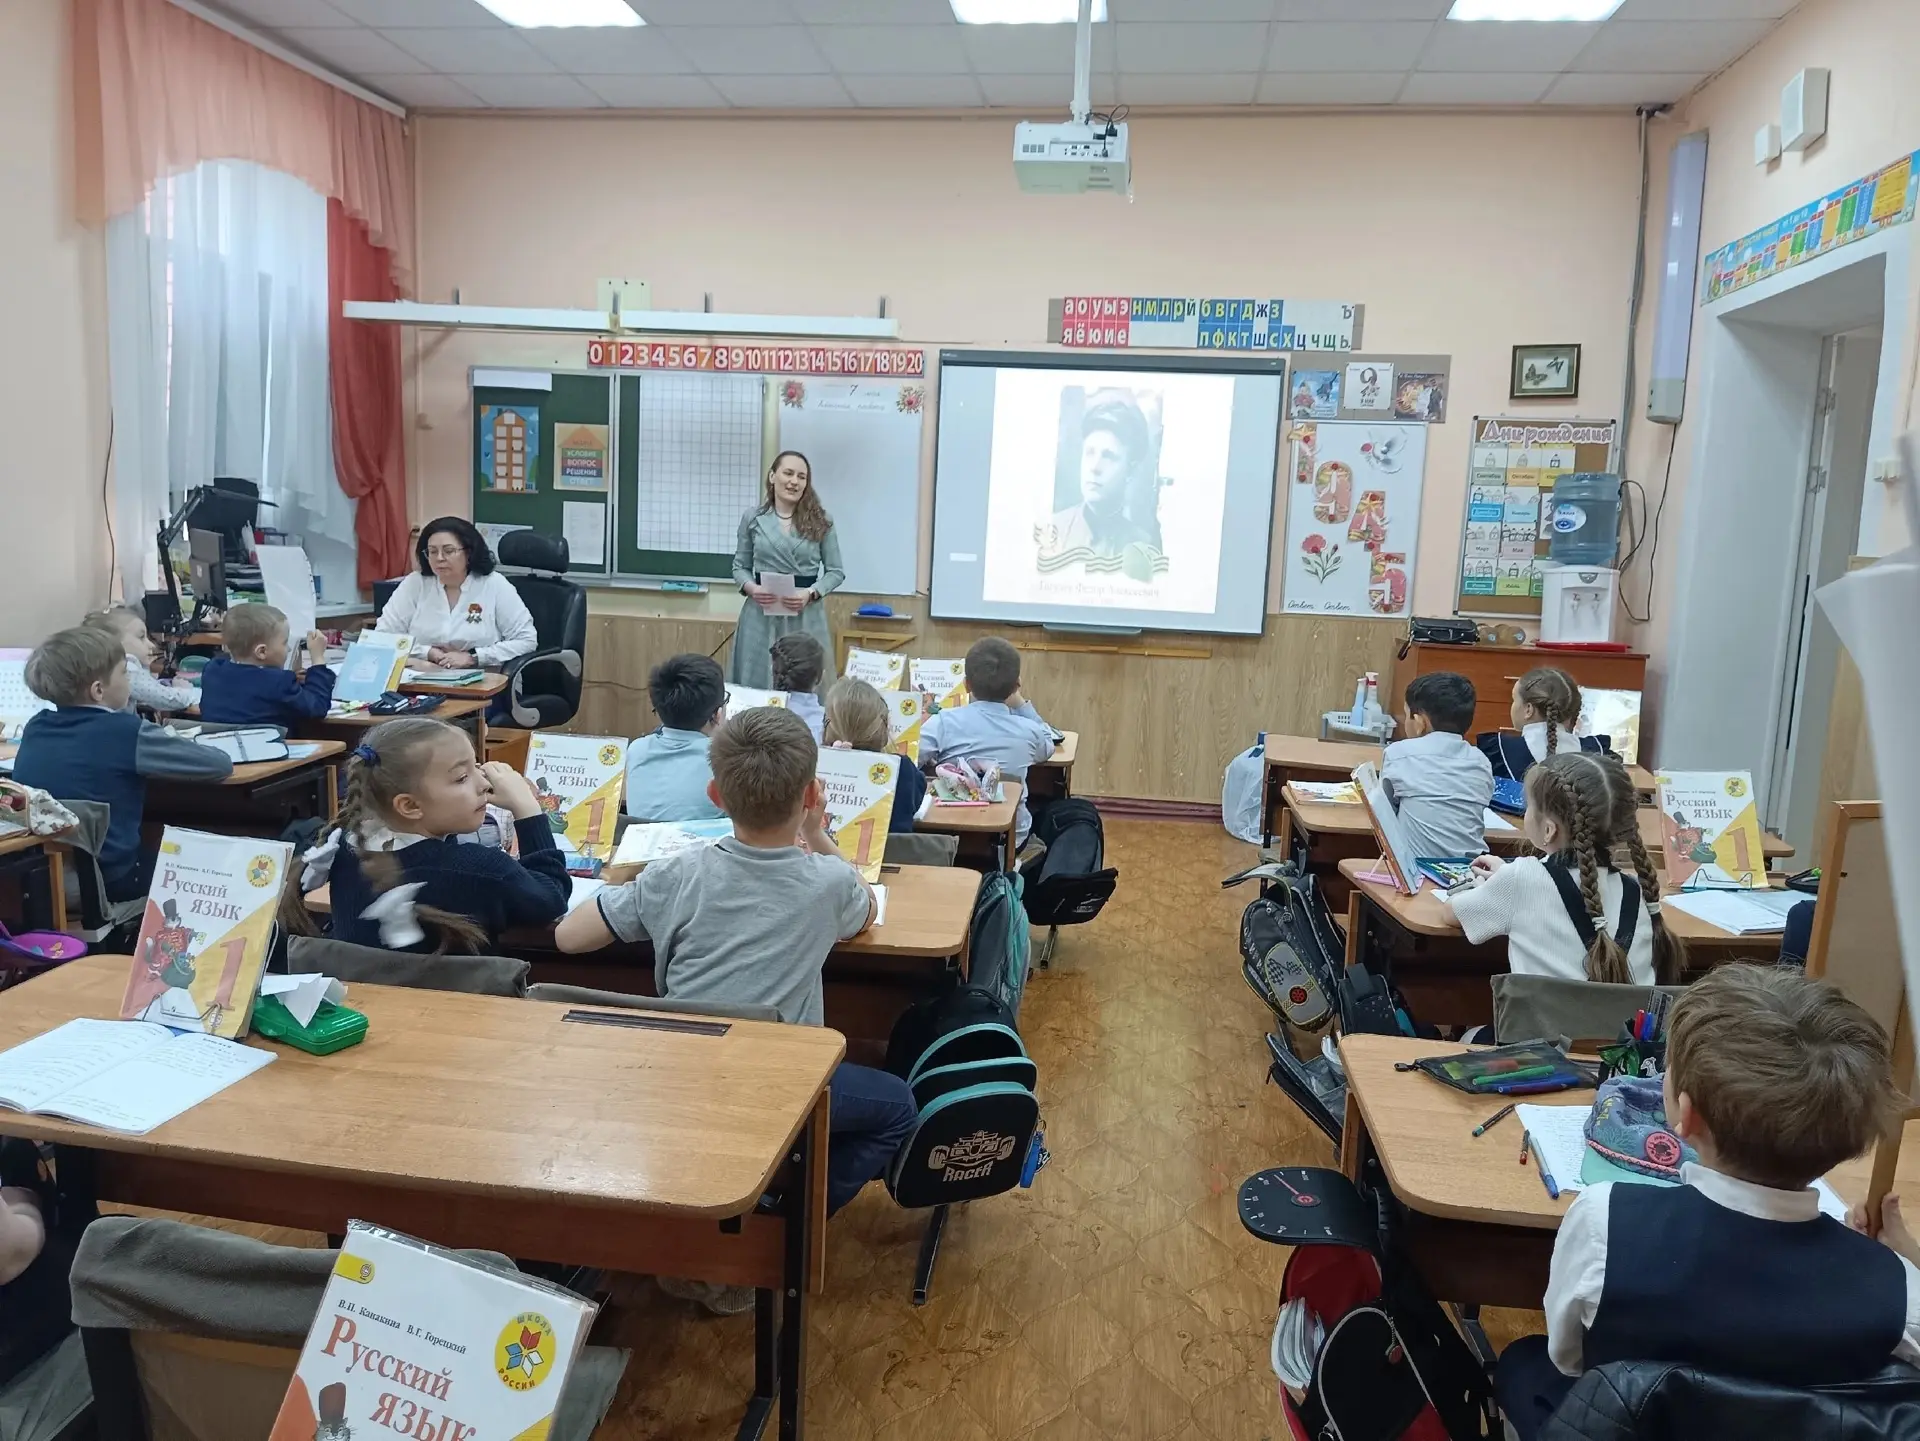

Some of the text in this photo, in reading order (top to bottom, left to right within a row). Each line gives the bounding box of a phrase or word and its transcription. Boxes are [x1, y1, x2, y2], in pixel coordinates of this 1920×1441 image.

[590, 344, 923, 373] 0 1 2 3 4 5 6 7 8 9 10 11 12 13 14 15 16 17 18 19 20
[849, 384, 858, 396] 7
[1482, 421, 1612, 449] Дни рождения
[566, 468, 597, 476] РЕШЕНИЕ
[567, 459, 596, 467] ВОПРОС
[533, 758, 586, 775] Русский
[1666, 794, 1717, 809] Русский
[579, 797, 606, 845] 1
[851, 818, 875, 866] 1
[1725, 826, 1757, 872] 1
[160, 869, 228, 898] Русский
[206, 937, 247, 1011] 1
[338, 1299, 467, 1355] В.П. Канакина В.Г. Горецкий
[517, 1314, 552, 1336] ШКОЛА
[320, 1313, 453, 1401] Русский
[499, 1368, 535, 1390] РОССИИ
